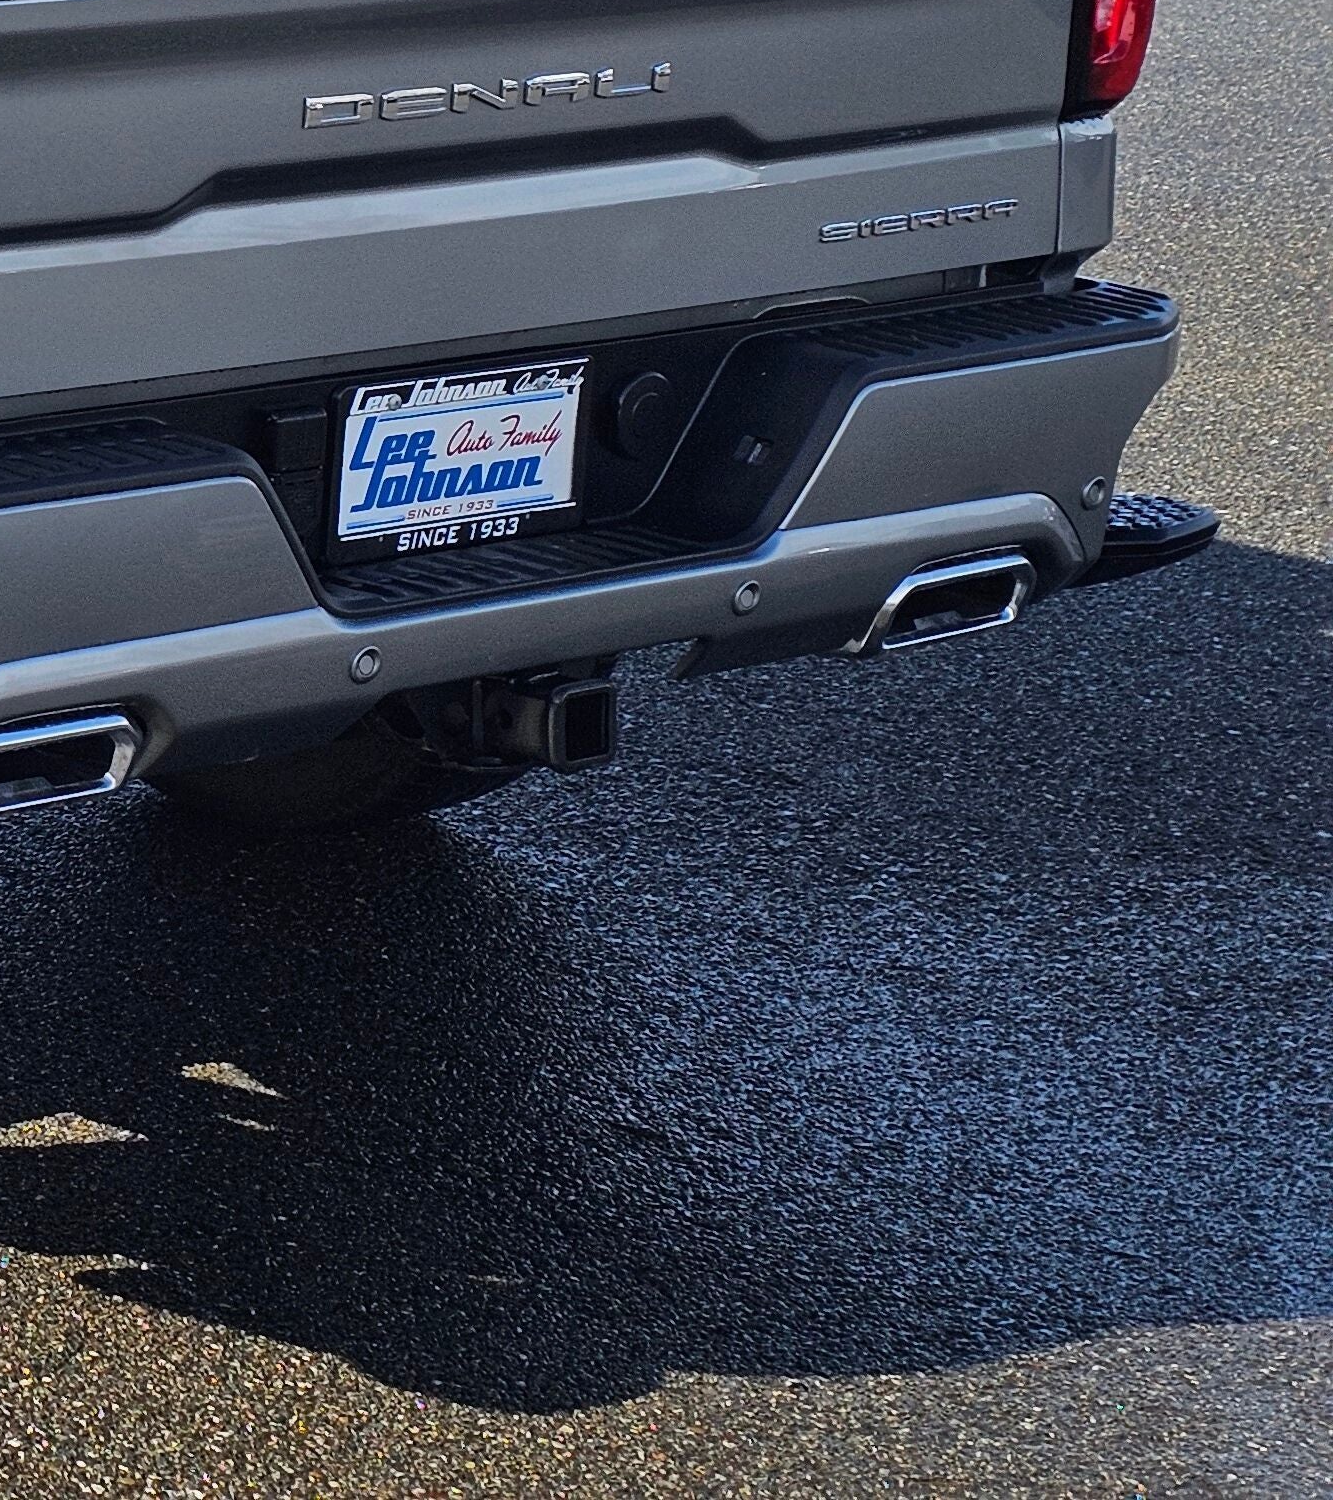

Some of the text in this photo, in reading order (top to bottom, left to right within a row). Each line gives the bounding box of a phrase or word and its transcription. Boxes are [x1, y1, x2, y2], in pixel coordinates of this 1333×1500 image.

[302, 61, 672, 129] DENALI
[819, 198, 1019, 243] SIERRA
[401, 377, 507, 408] Johnson
[349, 410, 563, 471] Lee Auto Family
[350, 455, 543, 513] Johnson
[406, 500, 494, 520] SINCE 1933
[397, 517, 520, 551] SINCE 1933
